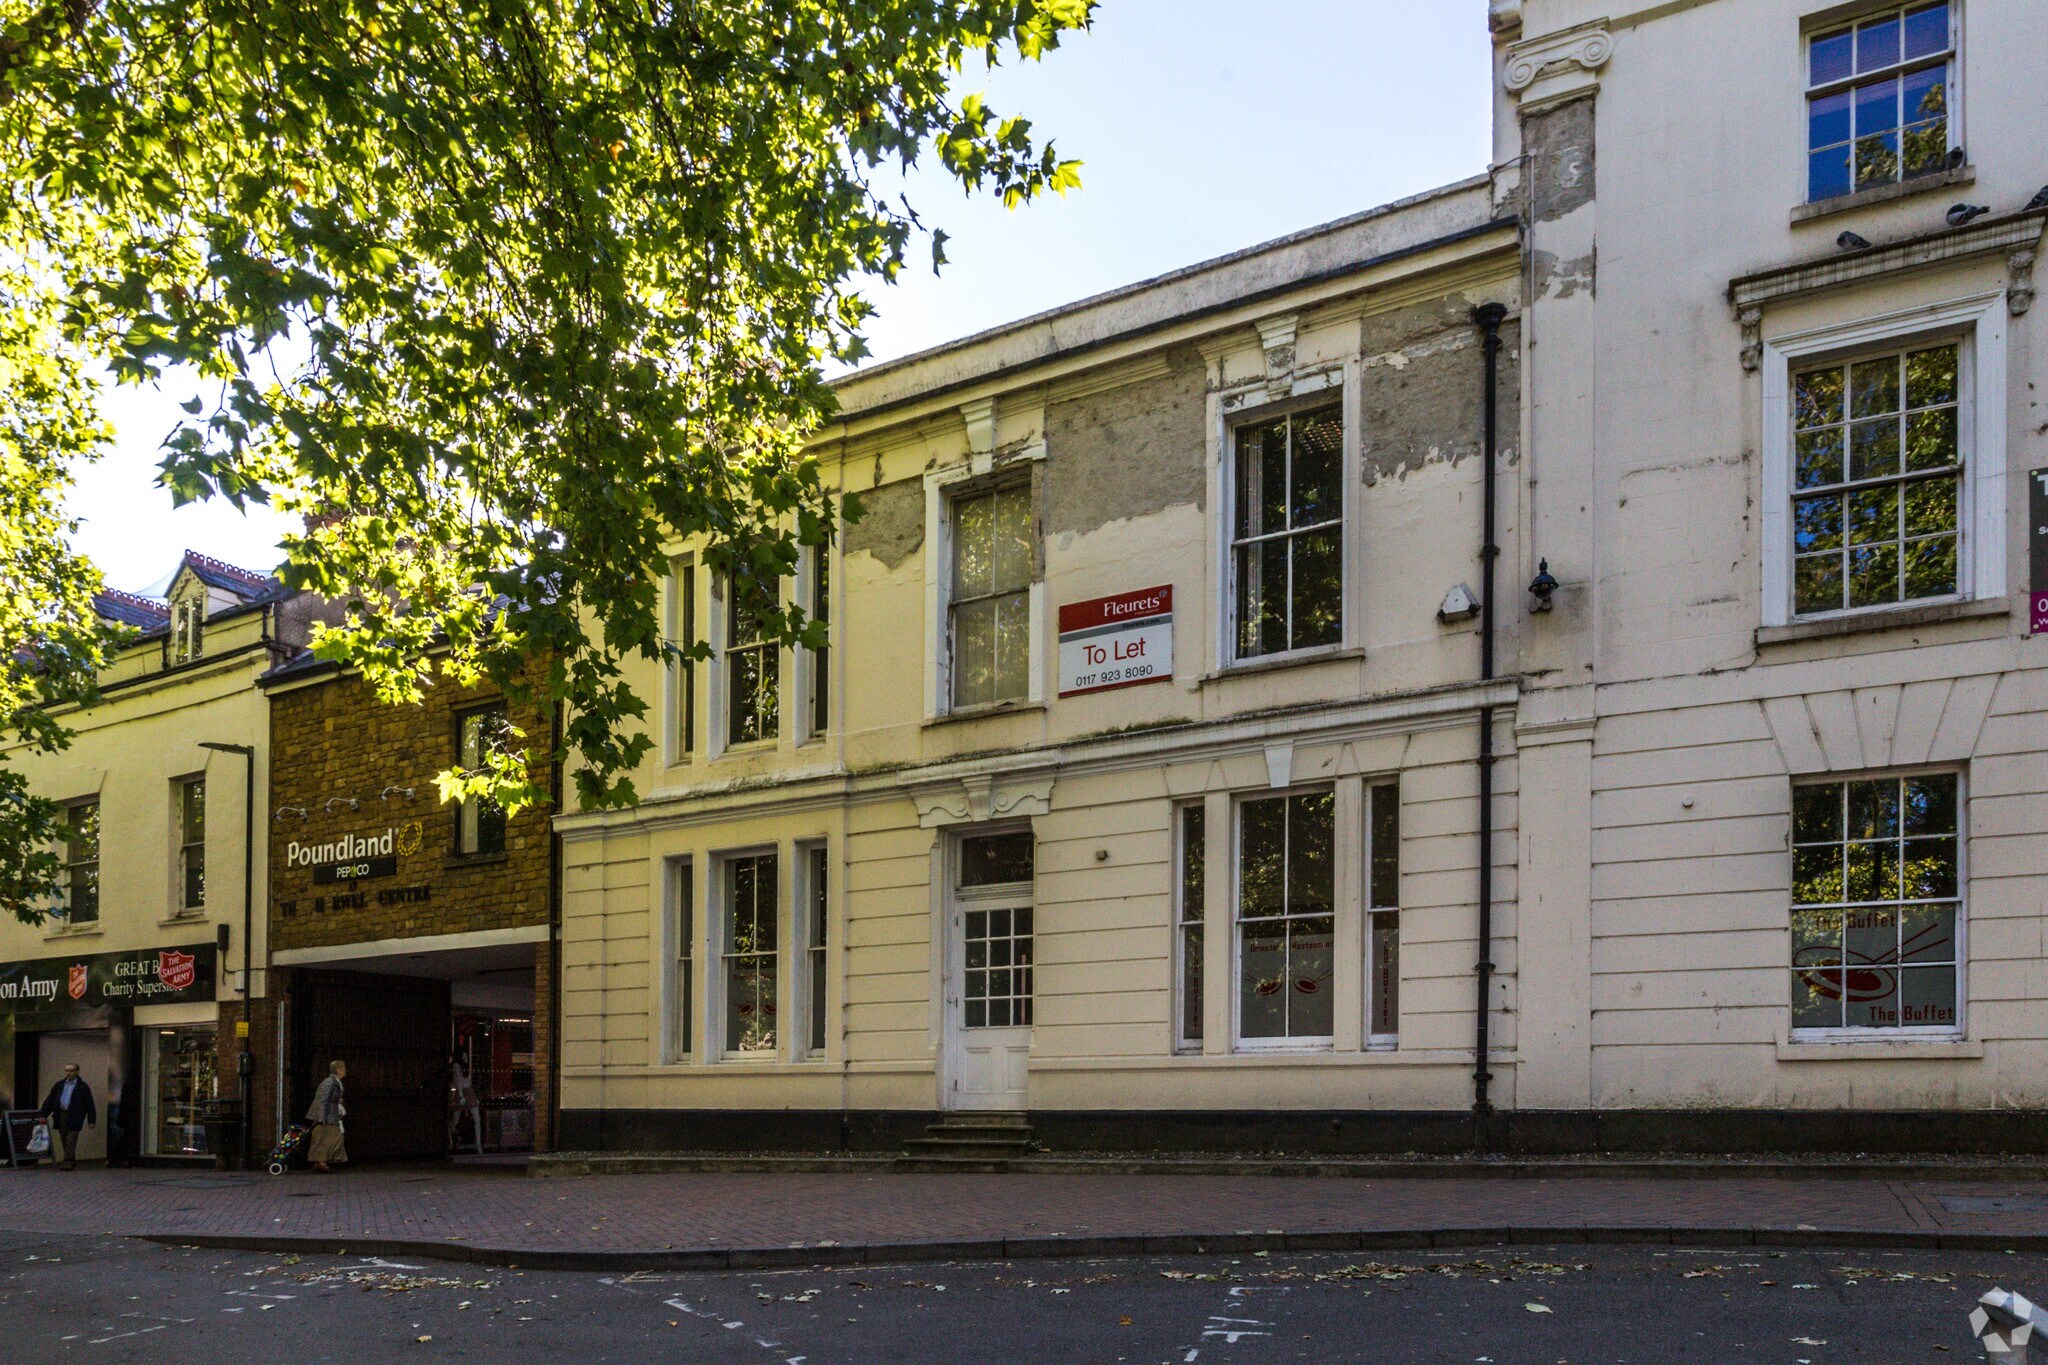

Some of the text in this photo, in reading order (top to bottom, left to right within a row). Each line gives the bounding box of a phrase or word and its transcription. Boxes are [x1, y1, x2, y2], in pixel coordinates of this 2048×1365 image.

[1104, 597, 1160, 617] Fleurets
[1083, 637, 1146, 666] To Let
[1076, 664, 1153, 687] 0117 923 8090
[287, 828, 393, 867] Poundland
[1848, 912, 1896, 929] Buffet
[115, 960, 150, 977] GREAT
[167, 956, 180, 966] THE
[173, 970, 191, 984] ARMY
[19, 975, 60, 1002] Army
[102, 980, 135, 999] Charity
[1869, 1005, 1953, 1022] The Buffet
